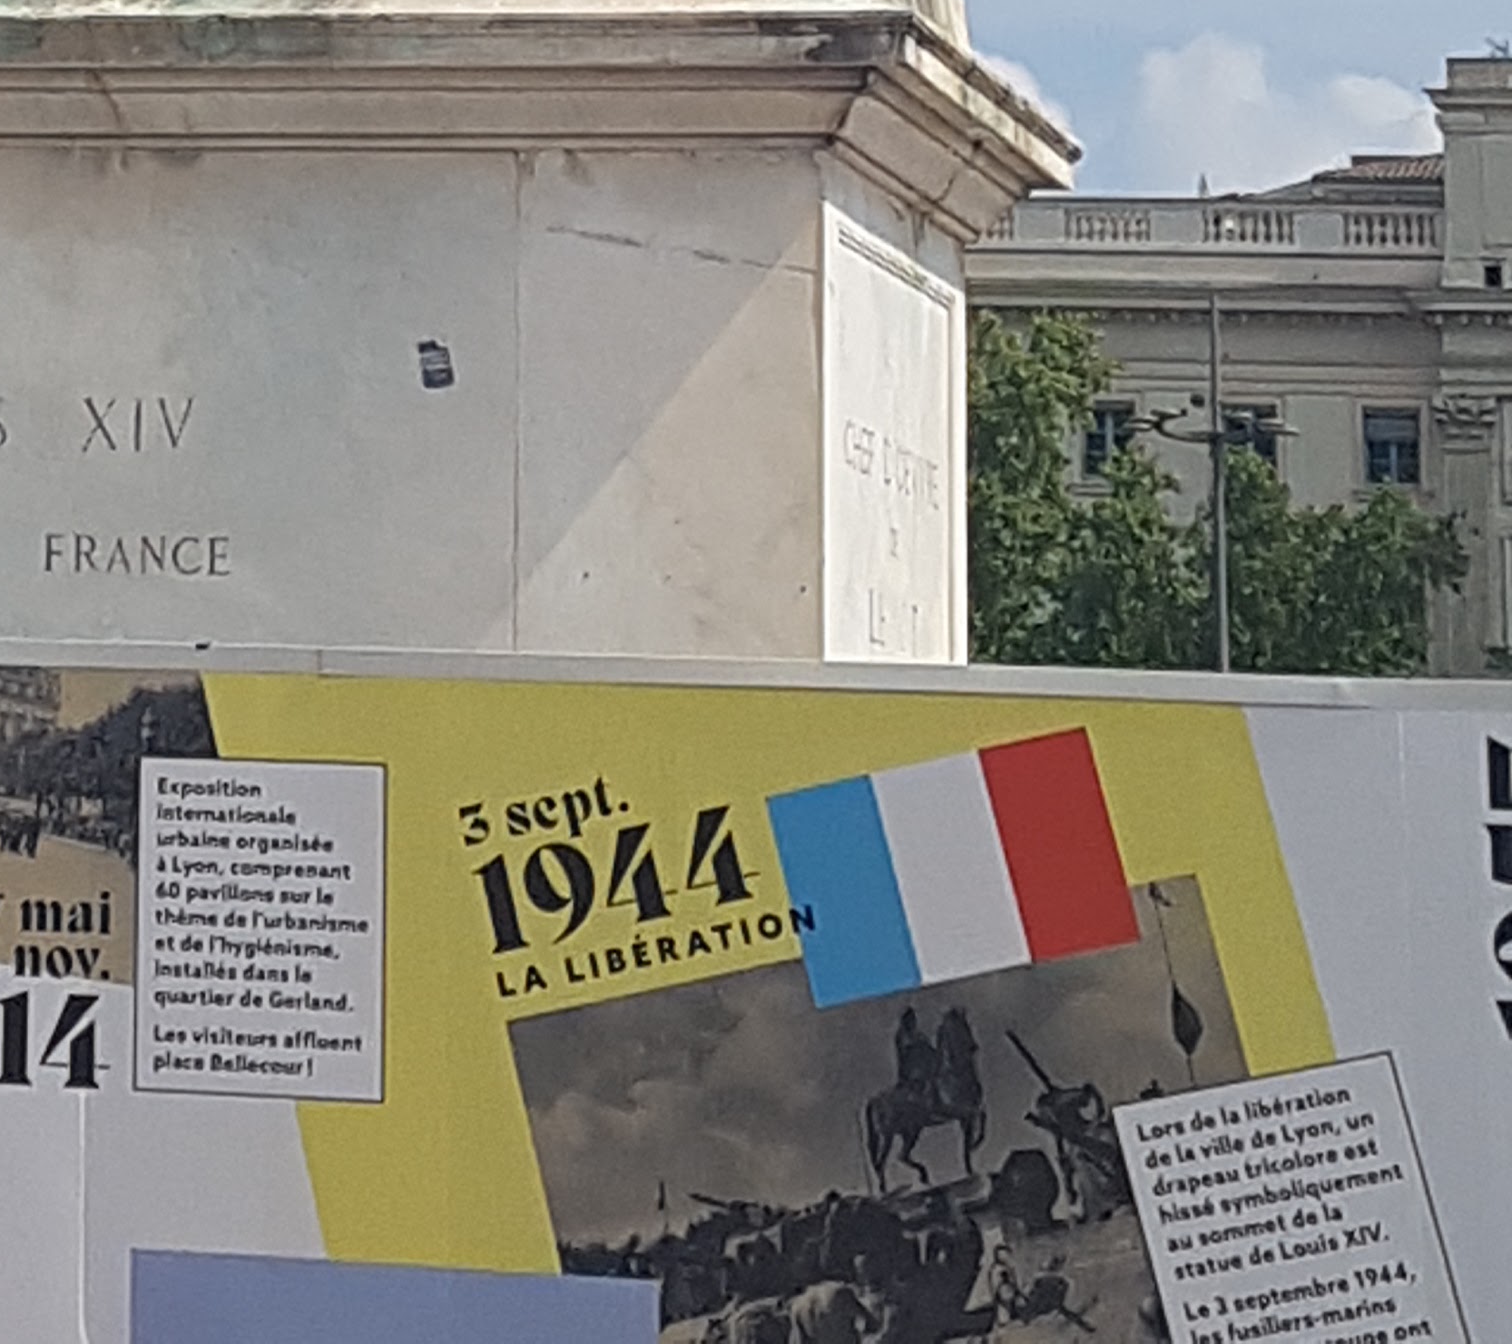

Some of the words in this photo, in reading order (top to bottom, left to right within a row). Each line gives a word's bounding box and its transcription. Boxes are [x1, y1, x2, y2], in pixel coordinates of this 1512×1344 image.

[81, 396, 194, 451] XIV
[43, 532, 231, 576] FRANCE
[157, 777, 262, 799] Exposition
[156, 803, 296, 824] internationale
[457, 802, 491, 846] 3
[504, 777, 630, 838] sept.
[156, 831, 230, 848] urbaine
[236, 833, 334, 854] organisée
[171, 856, 224, 877] Lyon,
[230, 861, 351, 880] comprenant
[472, 805, 761, 954] 1944
[20, 889, 111, 933] mai
[155, 881, 180, 898] 60
[186, 884, 273, 904] pavillons
[279, 890, 311, 904] sur
[316, 887, 334, 905] le
[155, 908, 217, 926] thème
[224, 910, 246, 928] de
[12, 943, 110, 979] nov.
[155, 936, 175, 951] et
[180, 935, 203, 952] de
[496, 960, 547, 997] LA
[564, 904, 816, 983] LIBÉRATION
[154, 960, 237, 980] installés
[243, 963, 289, 982] dans
[295, 965, 312, 982] le
[154, 989, 234, 1008] quartier
[239, 990, 262, 1008] de
[269, 991, 354, 1011] Gerland.
[153, 1025, 186, 1043] Les
[192, 1027, 277, 1047] visiteurs
[283, 1030, 362, 1051] affluent
[153, 1051, 204, 1072] place
[1136, 1120, 1184, 1142] Lors
[1190, 1110, 1216, 1132] de
[1220, 1107, 1240, 1126] la
[1244, 1088, 1351, 1121] libération
[1145, 1148, 1171, 1170] de
[1176, 1144, 1195, 1163] la
[1200, 1136, 1244, 1157] ville
[1251, 1130, 1276, 1150] de
[1281, 1119, 1341, 1145] Lyon,
[1345, 1113, 1374, 1131] un
[1153, 1169, 1240, 1197] drapeau
[1245, 1148, 1338, 1178] tricolore
[1344, 1139, 1378, 1159] est
[1158, 1197, 1214, 1225] hissé
[1220, 1164, 1404, 1215] symboliquement
[1168, 1236, 1193, 1252] au
[1199, 1215, 1286, 1247] sommet
[1292, 1208, 1318, 1228] de
[1324, 1203, 1343, 1222] la
[1175, 1257, 1243, 1280] statue
[1249, 1246, 1274, 1265] de
[1279, 1234, 1339, 1260] Louis
[1343, 1222, 1389, 1248] XIV.
[1184, 1302, 1210, 1321] Le
[1215, 1296, 1228, 1314] 3
[1234, 1277, 1350, 1311] septembre
[1354, 1262, 1416, 1288] 1944,
[1228, 1298, 1396, 1342] fusiliers-marins
[1394, 1319, 1432, 1340] ont
